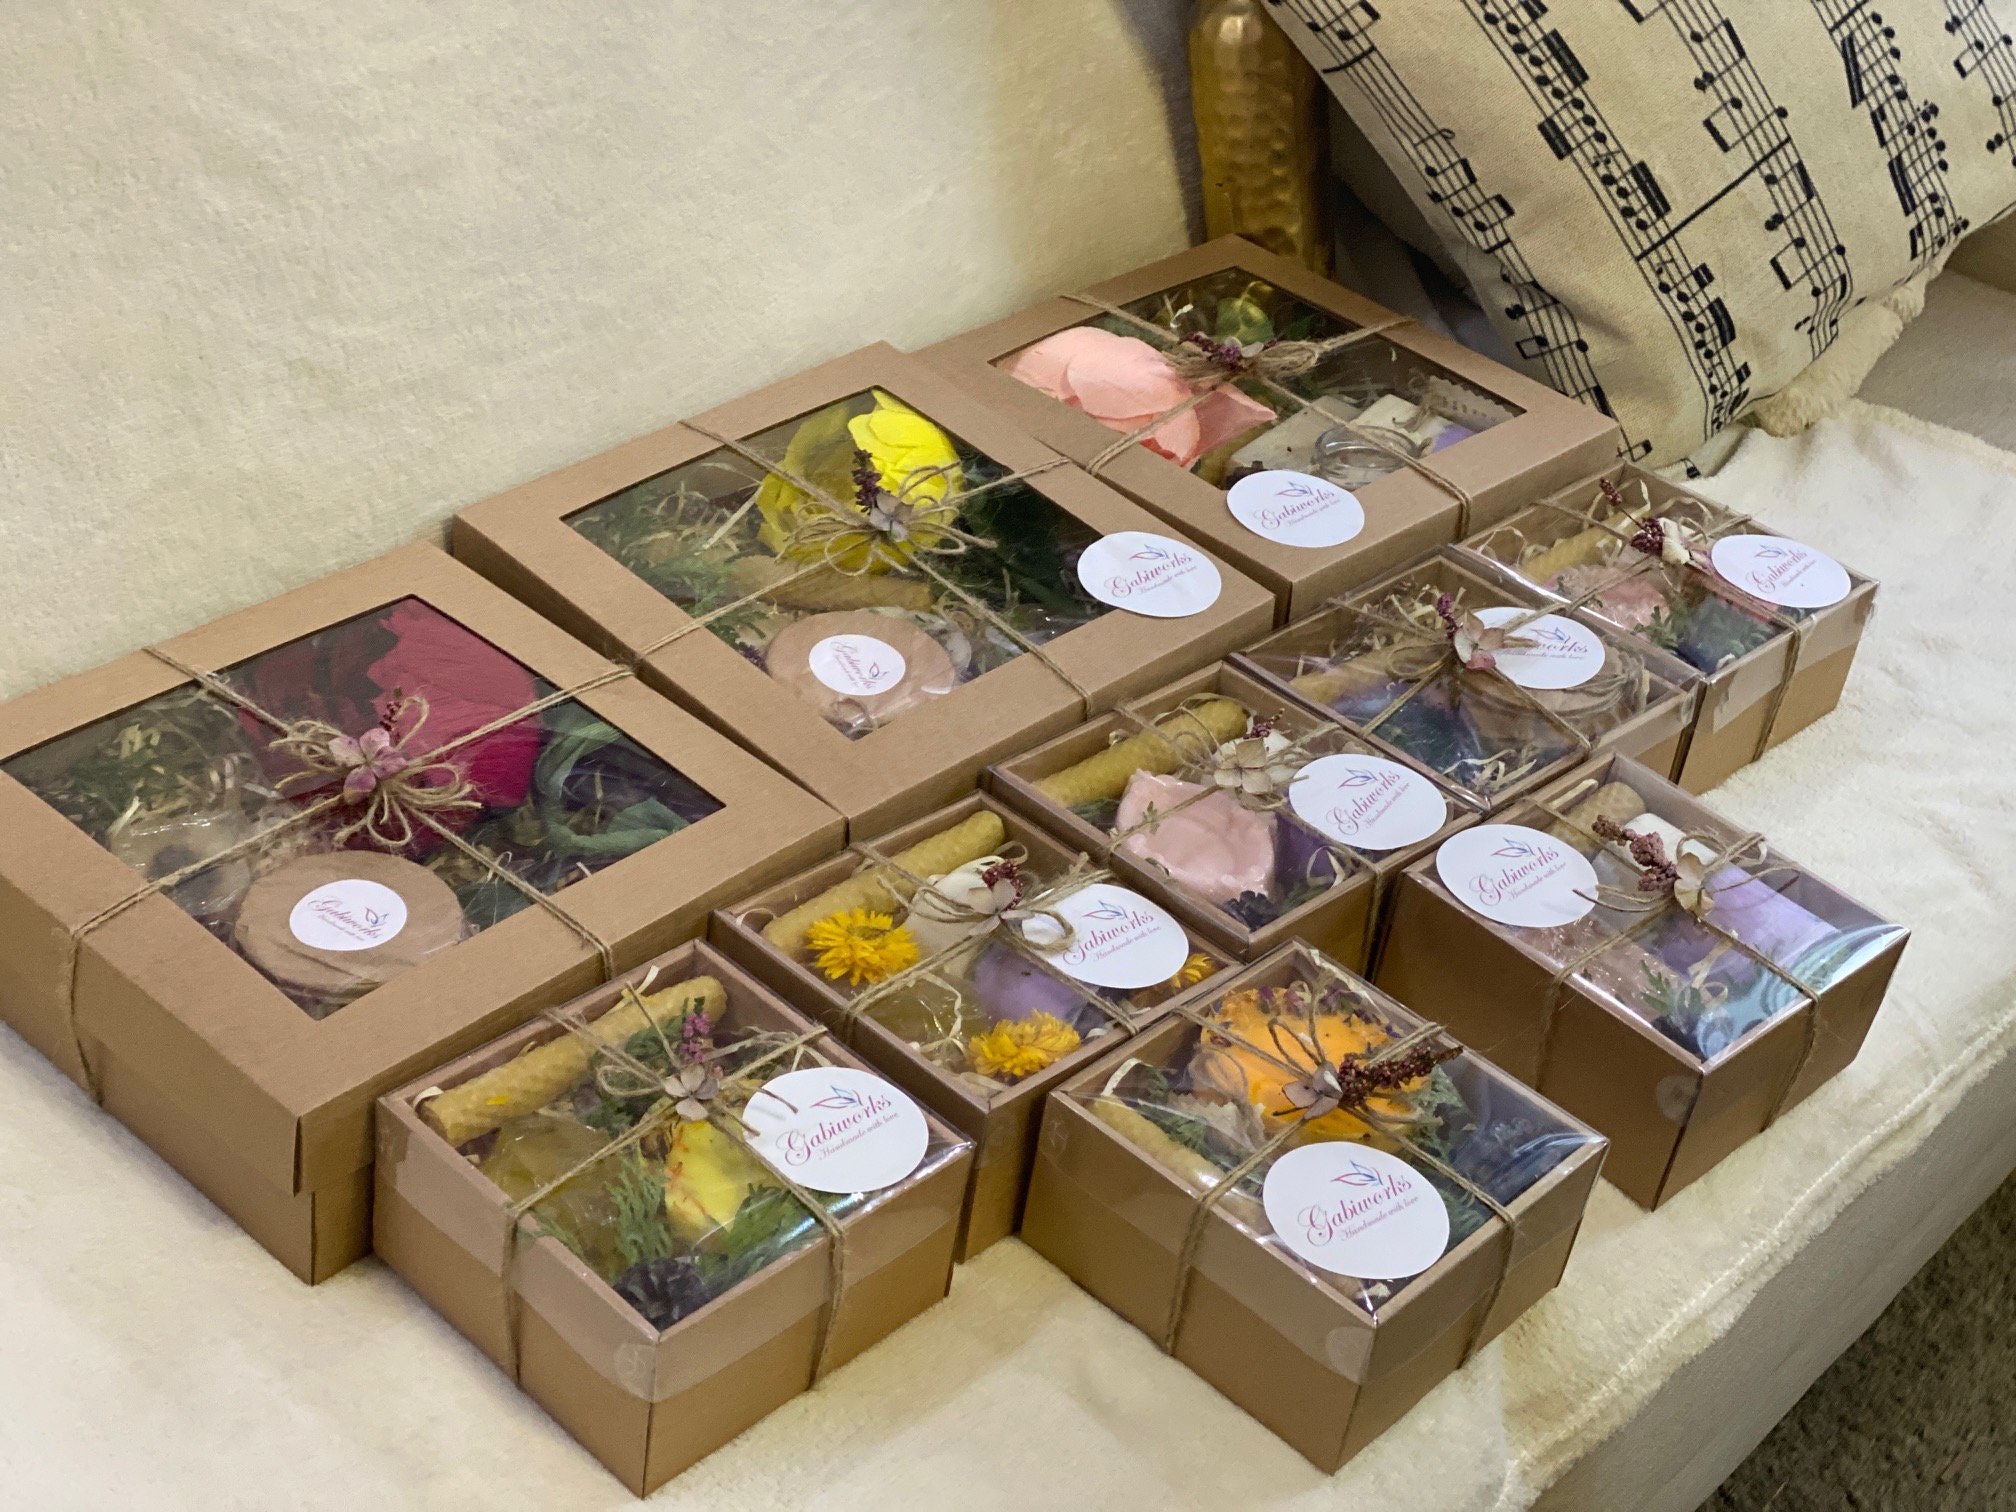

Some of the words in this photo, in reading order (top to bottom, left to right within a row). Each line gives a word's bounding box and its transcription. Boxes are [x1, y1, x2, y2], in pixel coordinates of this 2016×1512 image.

[1326, 770, 1400, 835] Gabiworks
[1469, 846, 1559, 907] Gabiworks
[775, 1095, 892, 1166] Gabiworks
[1297, 1174, 1413, 1247] Gabiworks
